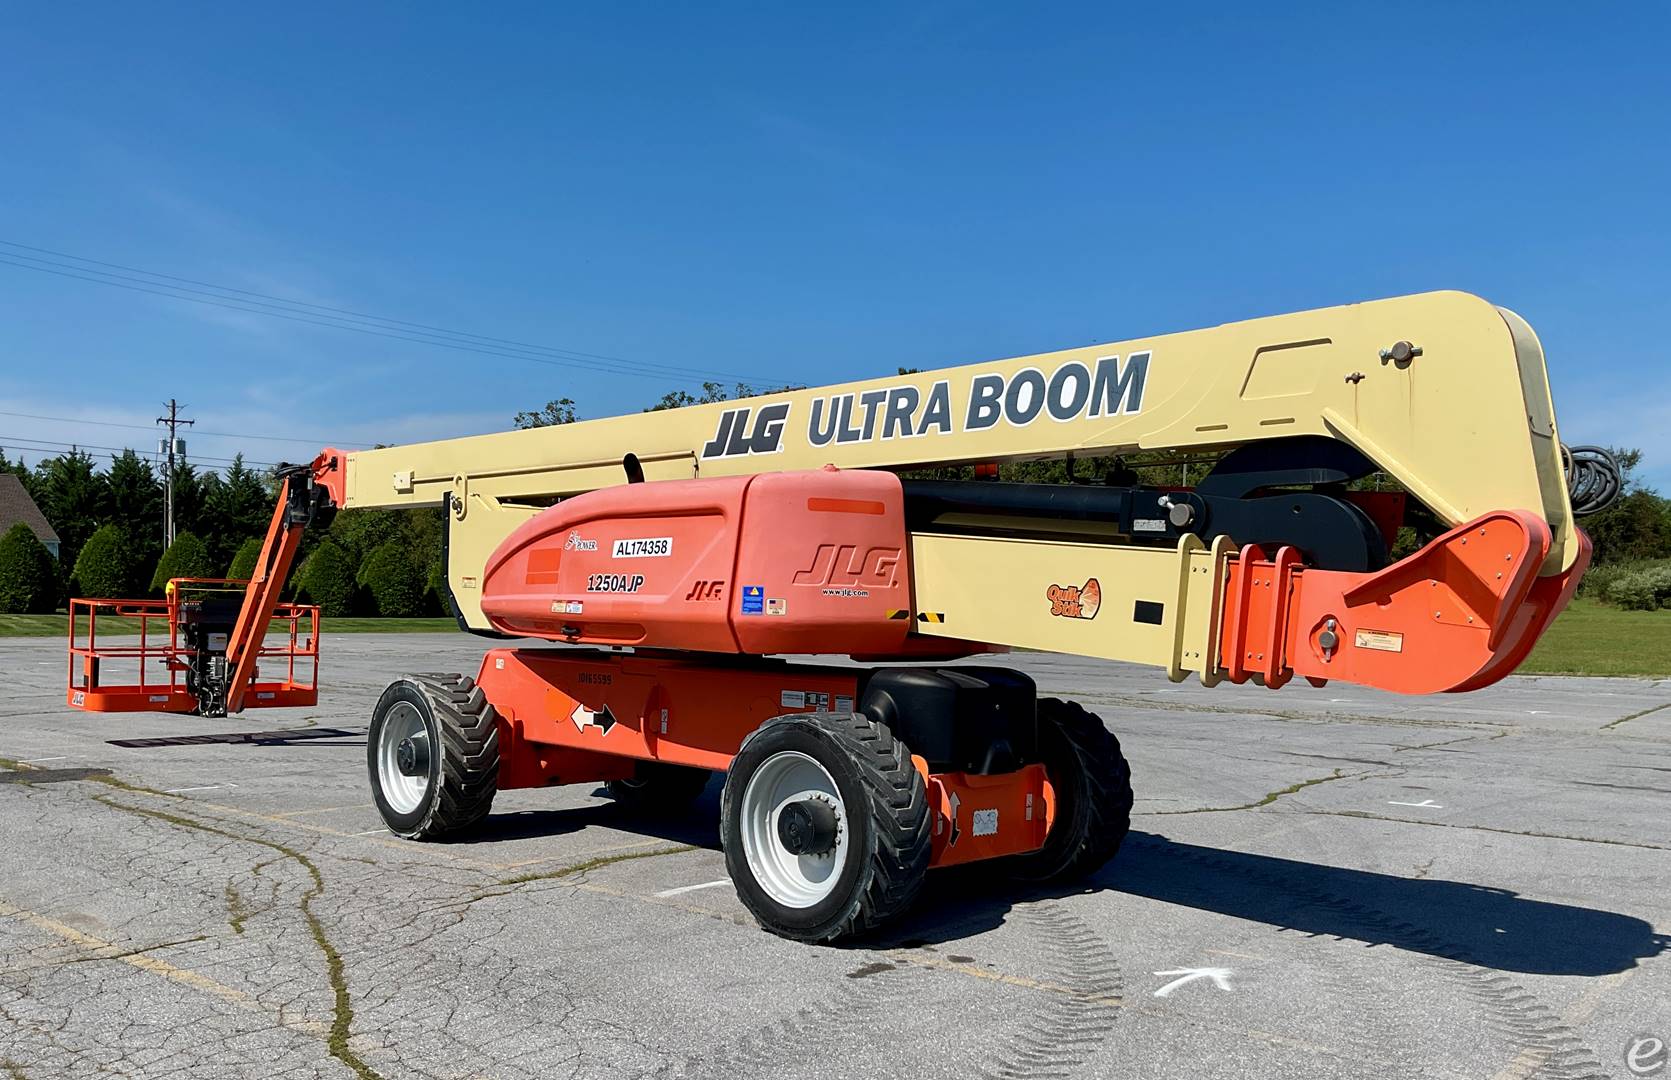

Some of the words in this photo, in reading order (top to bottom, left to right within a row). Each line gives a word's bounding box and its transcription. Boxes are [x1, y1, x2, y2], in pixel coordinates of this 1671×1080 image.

[701, 402, 791, 459] JLG
[808, 380, 952, 448] ULTRA
[964, 350, 1153, 430] BOOM
[616, 540, 668, 556] AL174358
[792, 543, 902, 589] JLG
[587, 574, 644, 593] 1250AJP
[821, 588, 869, 597] www.jlg.com
